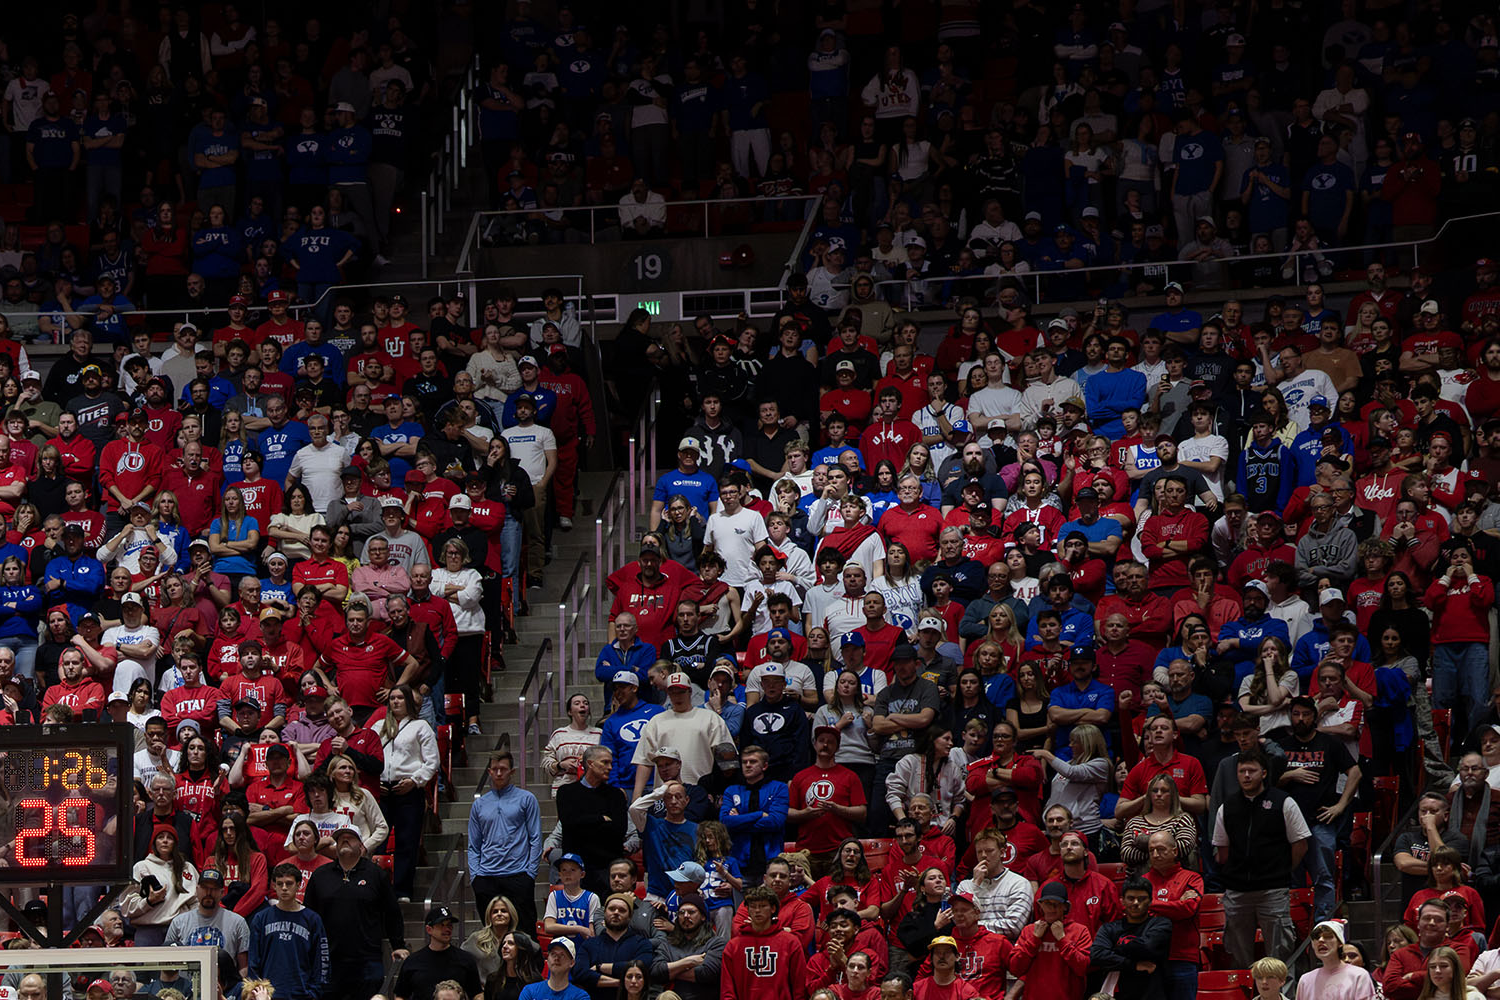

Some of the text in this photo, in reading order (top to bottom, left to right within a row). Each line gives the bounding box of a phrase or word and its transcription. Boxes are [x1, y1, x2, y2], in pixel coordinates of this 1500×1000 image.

[1452, 156, 1477, 173] 10
[205, 232, 229, 245] BYU
[300, 235, 330, 247] BYU
[634, 254, 662, 279] 19
[79, 407, 110, 424] UTES
[267, 434, 288, 446] BYU
[871, 432, 903, 447] UTAH
[1137, 458, 1162, 469] BYU
[1246, 462, 1279, 480] BYU
[1255, 478, 1268, 493] 3
[245, 502, 263, 511] TAH
[1309, 546, 1339, 562] BYU
[261, 593, 287, 603] BYU
[882, 586, 920, 609] BYU
[43, 753, 108, 788] 1:26
[818, 784, 831, 797] U
[14, 797, 96, 867] 25
[558, 906, 586, 920] BYU
